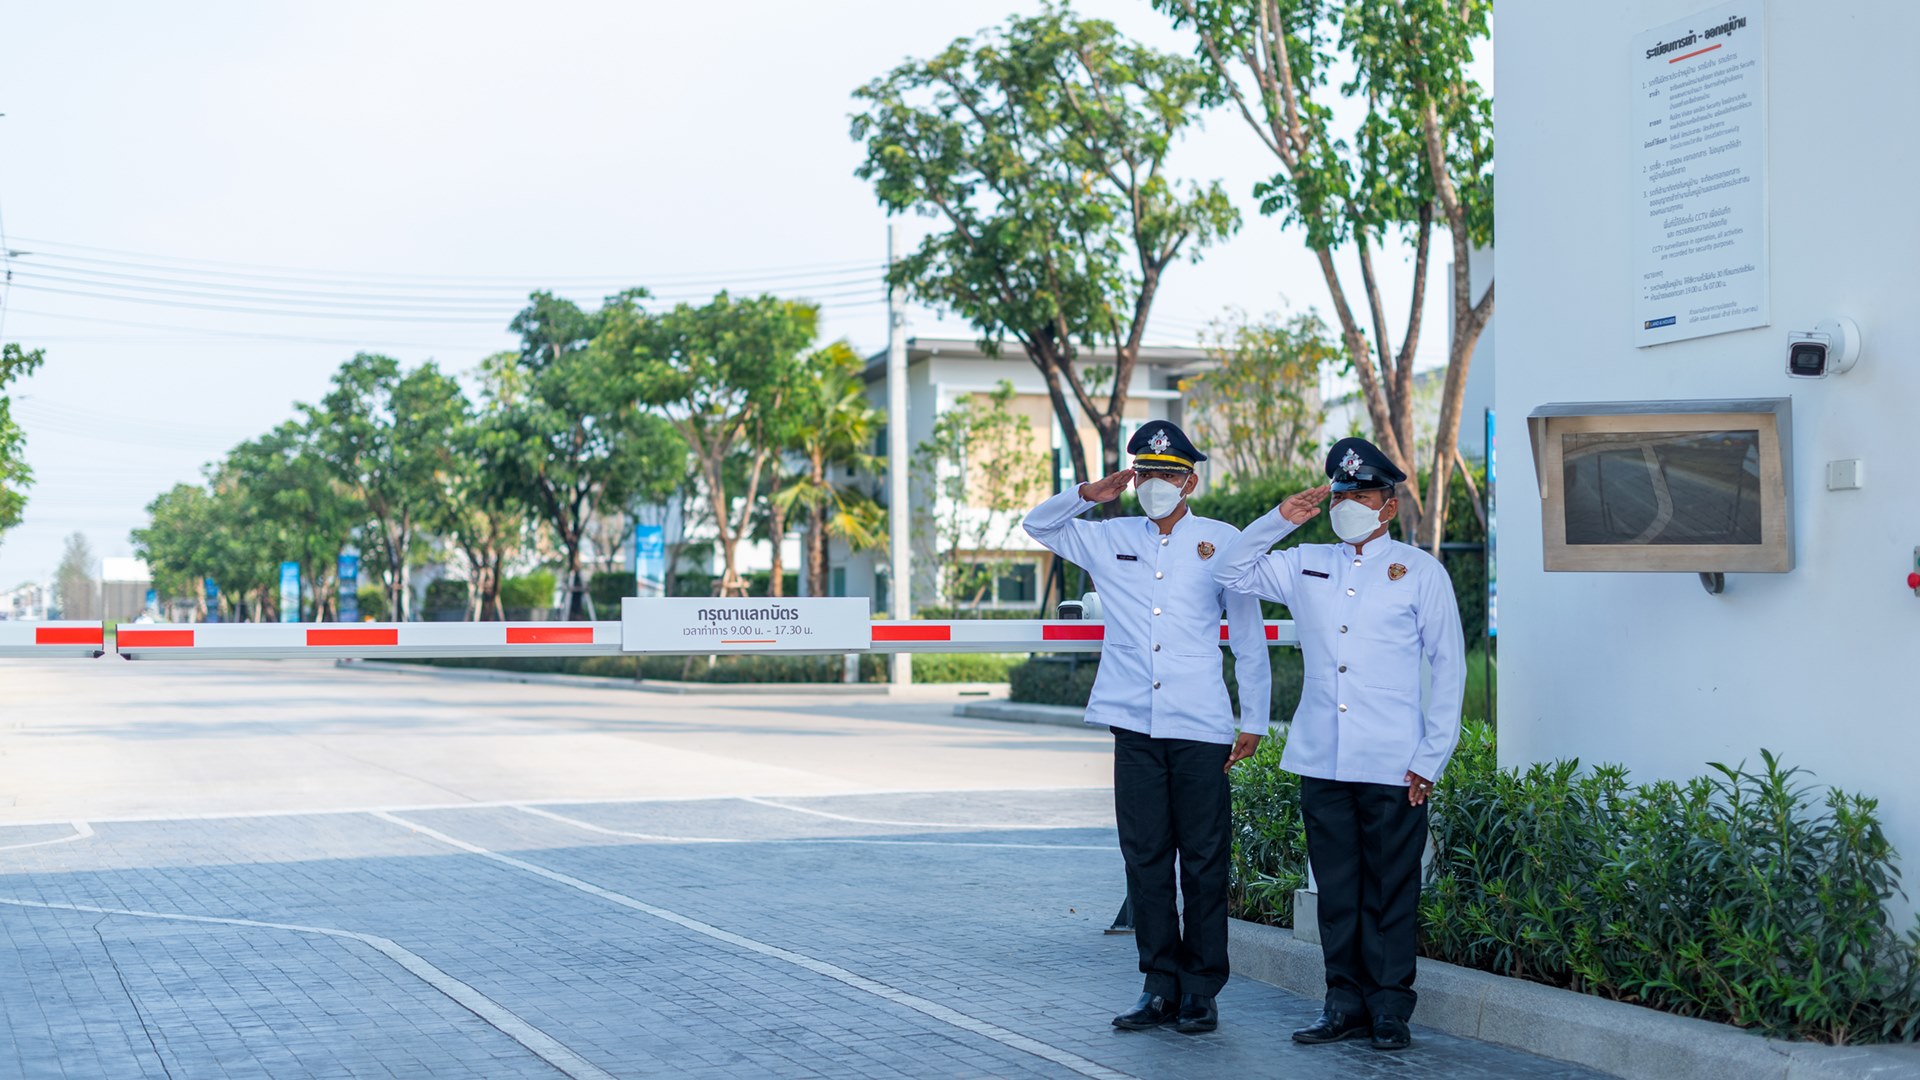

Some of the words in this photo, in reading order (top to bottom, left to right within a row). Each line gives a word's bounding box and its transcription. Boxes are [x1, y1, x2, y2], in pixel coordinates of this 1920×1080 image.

[1646, 30, 1697, 59] ระเบียบการเข้า
[1705, 16, 1746, 39] ออกหมู่บ้าน
[1695, 212, 1708, 221] CCTV
[1652, 245, 1664, 253] CCTV
[1664, 240, 1689, 250] surveillance
[1695, 234, 1717, 244] operation,
[1724, 228, 1743, 237] activities
[1669, 249, 1687, 258] recorded
[1695, 244, 1712, 252] security
[1713, 240, 1734, 250] purposes.
[698, 604, 799, 626] กรุณาแลกบัตร
[683, 625, 728, 636] เวลาทำการ
[731, 625, 752, 635] 9.00
[754, 627, 763, 635] น.
[775, 625, 802, 635] 17.30
[804, 627, 813, 635] น.
